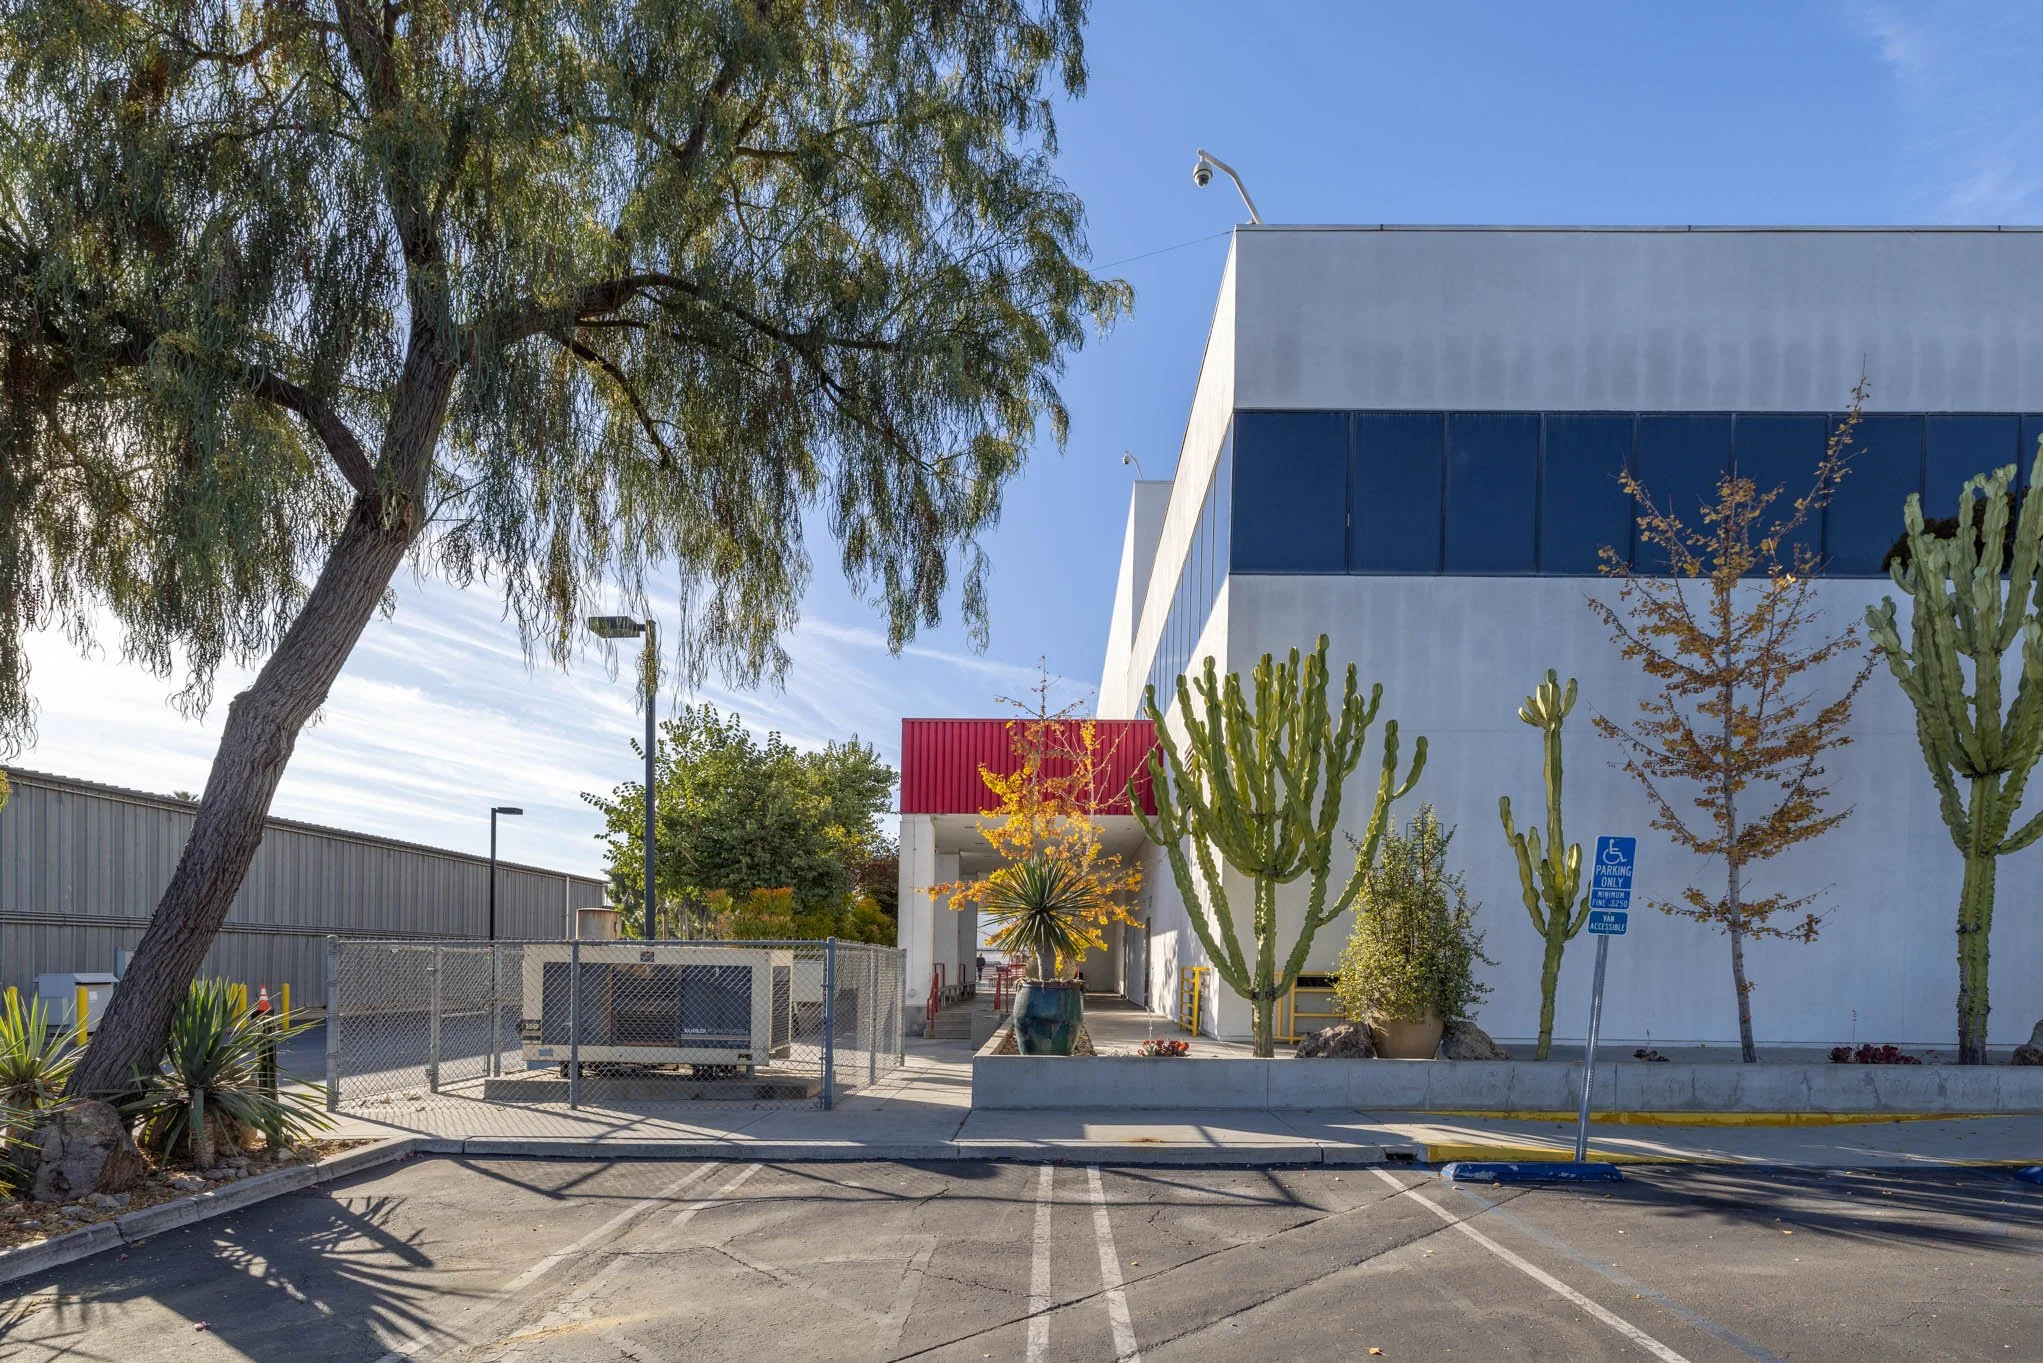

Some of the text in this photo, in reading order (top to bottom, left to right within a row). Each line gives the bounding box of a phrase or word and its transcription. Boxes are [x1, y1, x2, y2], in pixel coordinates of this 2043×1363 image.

[1596, 864, 1632, 877] PARKING
[1601, 876, 1624, 888] ONLY
[1597, 890, 1624, 899] MINIMUM
[1611, 899, 1628, 907] $250
[1589, 922, 1625, 932] ACCESSIBLE
